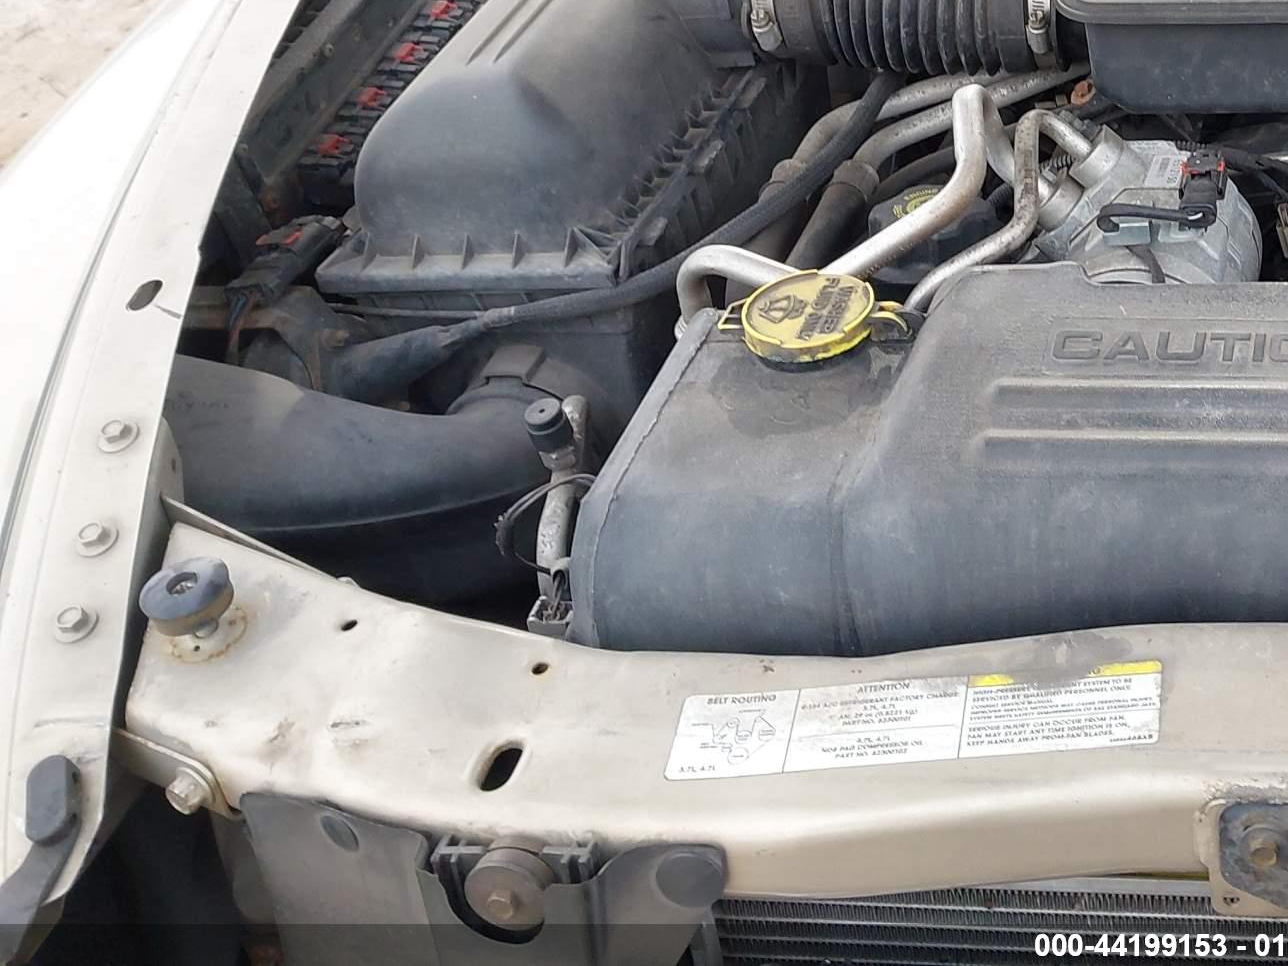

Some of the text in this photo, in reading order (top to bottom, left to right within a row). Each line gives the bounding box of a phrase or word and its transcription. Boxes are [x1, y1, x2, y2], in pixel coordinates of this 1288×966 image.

[1084, 678, 1110, 686] SYSTEM
[857, 683, 911, 694] ATTENTION
[1064, 686, 1108, 694] PERSONNEL
[707, 694, 776, 705] BELT ROUTING
